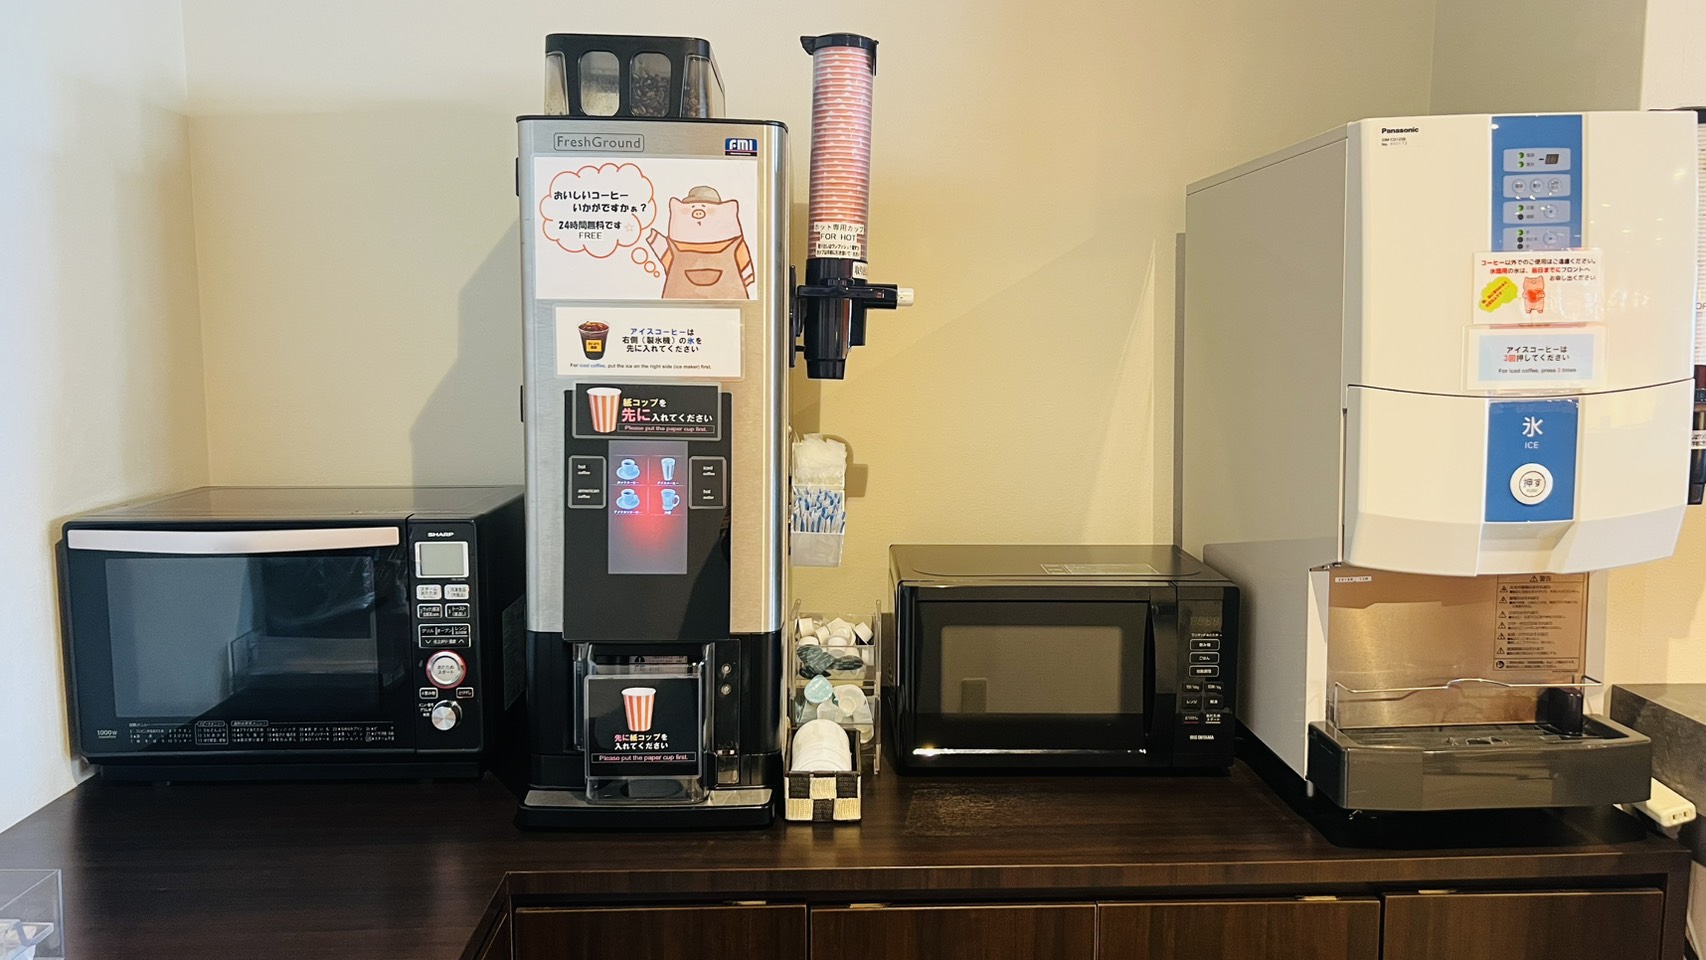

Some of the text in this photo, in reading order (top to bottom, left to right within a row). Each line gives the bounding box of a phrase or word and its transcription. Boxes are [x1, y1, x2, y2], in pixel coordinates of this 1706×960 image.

[556, 136, 641, 149] FreshGround
[553, 190, 629, 201] おいしいコーヒー
[558, 220, 622, 230] 24時間無料です
[578, 231, 603, 240] FREE
[840, 233, 856, 241] HOT
[630, 328, 695, 336] アイスコーヒーは
[621, 336, 702, 345] 右側（製氷機）の氷を
[626, 344, 700, 354] 先に入れてください
[1506, 345, 1568, 354] アイスコーヒーは
[622, 398, 667, 408] 紙コップを
[621, 407, 714, 423] 先に入れてください
[1521, 416, 1544, 437] 氷
[1524, 441, 1540, 449] ICE
[1523, 478, 1542, 488] 押す
[614, 733, 668, 742] 先に紙コップを
[614, 742, 669, 751] 入れてください
[620, 755, 632, 763] put
[662, 754, 675, 762] cup
